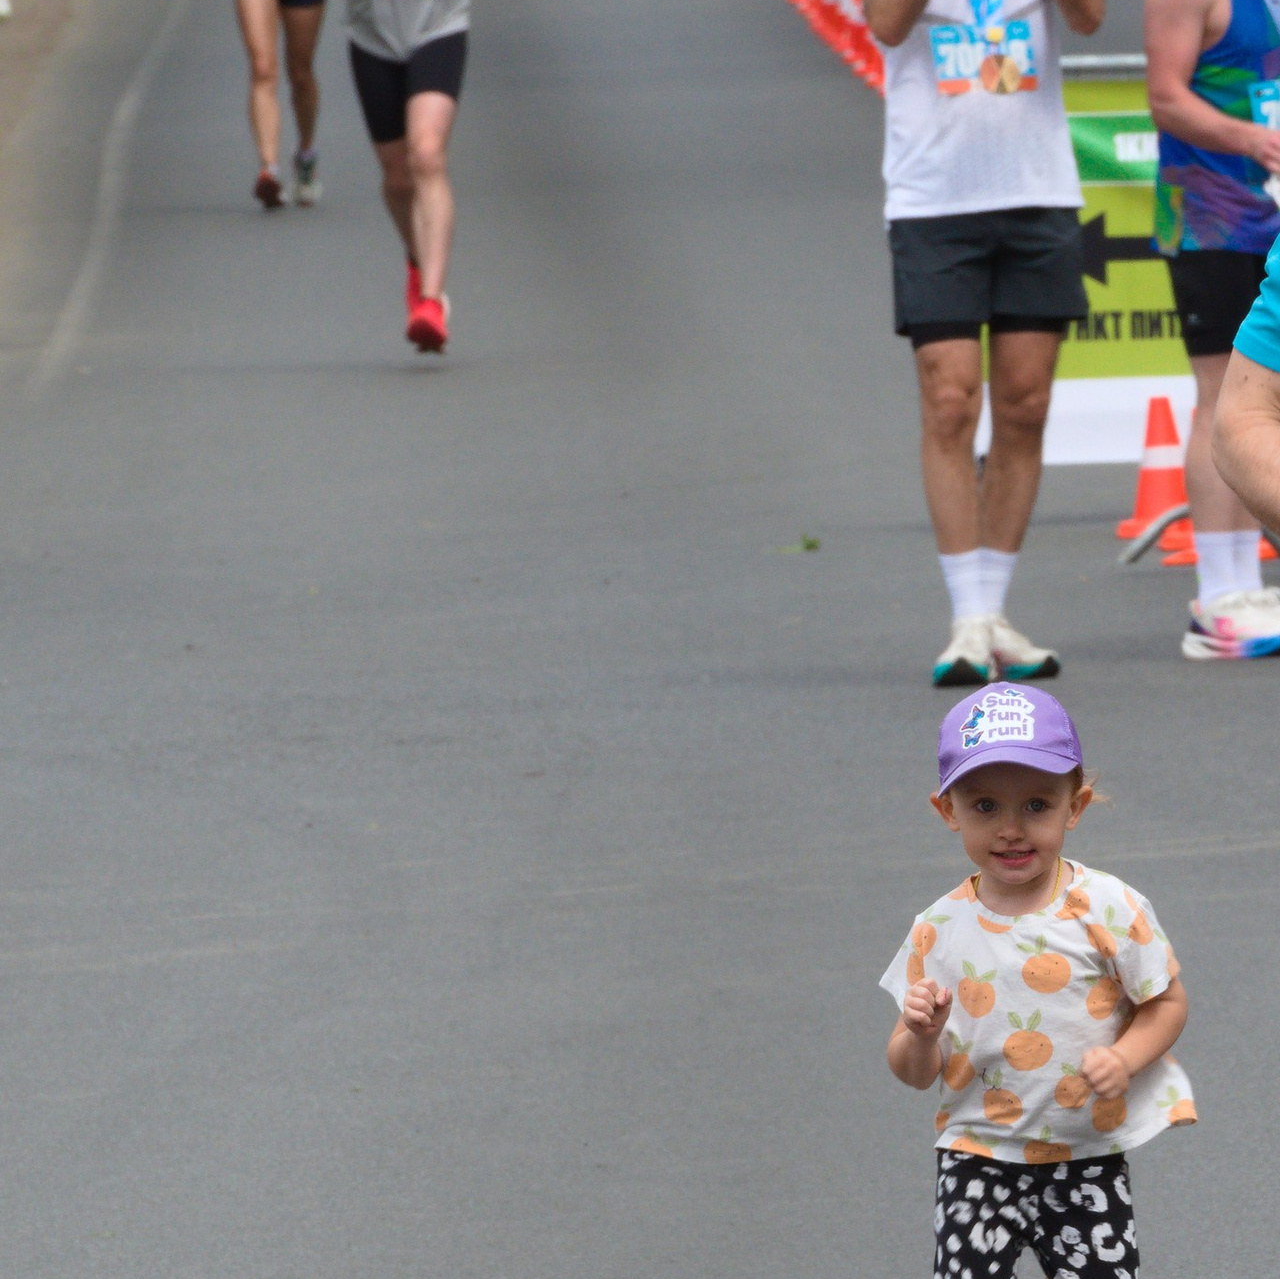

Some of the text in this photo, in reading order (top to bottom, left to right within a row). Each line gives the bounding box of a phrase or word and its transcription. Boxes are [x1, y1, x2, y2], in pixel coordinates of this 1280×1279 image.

[1074, 311, 1180, 340] НКТ ПИТ
[986, 695, 1029, 709] Sun,
[987, 708, 1028, 723] fun,
[988, 724, 1028, 738] run!
